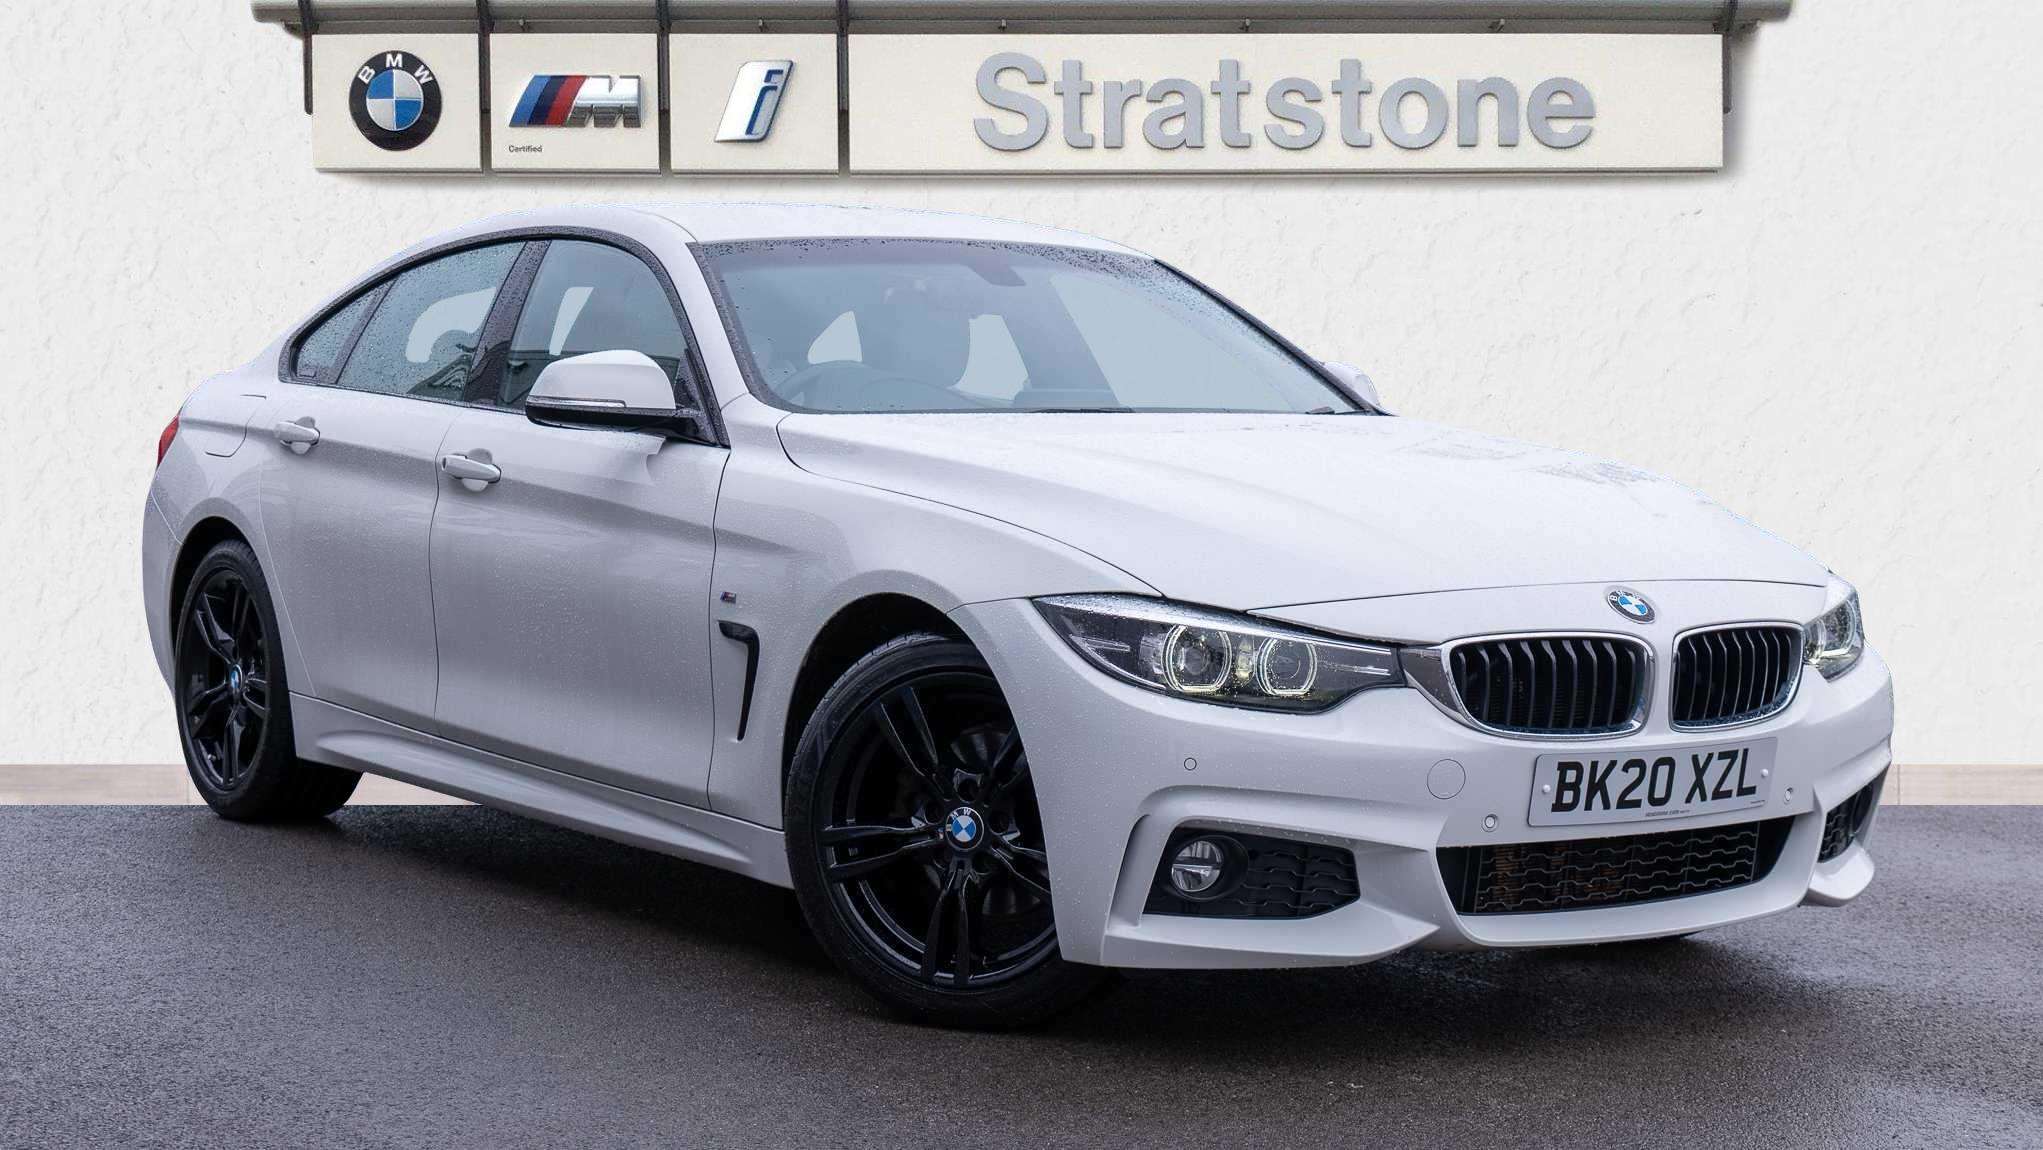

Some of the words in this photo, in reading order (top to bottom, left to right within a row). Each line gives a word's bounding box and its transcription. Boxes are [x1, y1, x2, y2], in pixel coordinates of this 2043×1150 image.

[358, 54, 433, 84] BMW
[974, 52, 1596, 150] Stratstone
[508, 144, 543, 153] Certified
[1551, 757, 1676, 812] BK20
[1685, 748, 1757, 804] XZL
